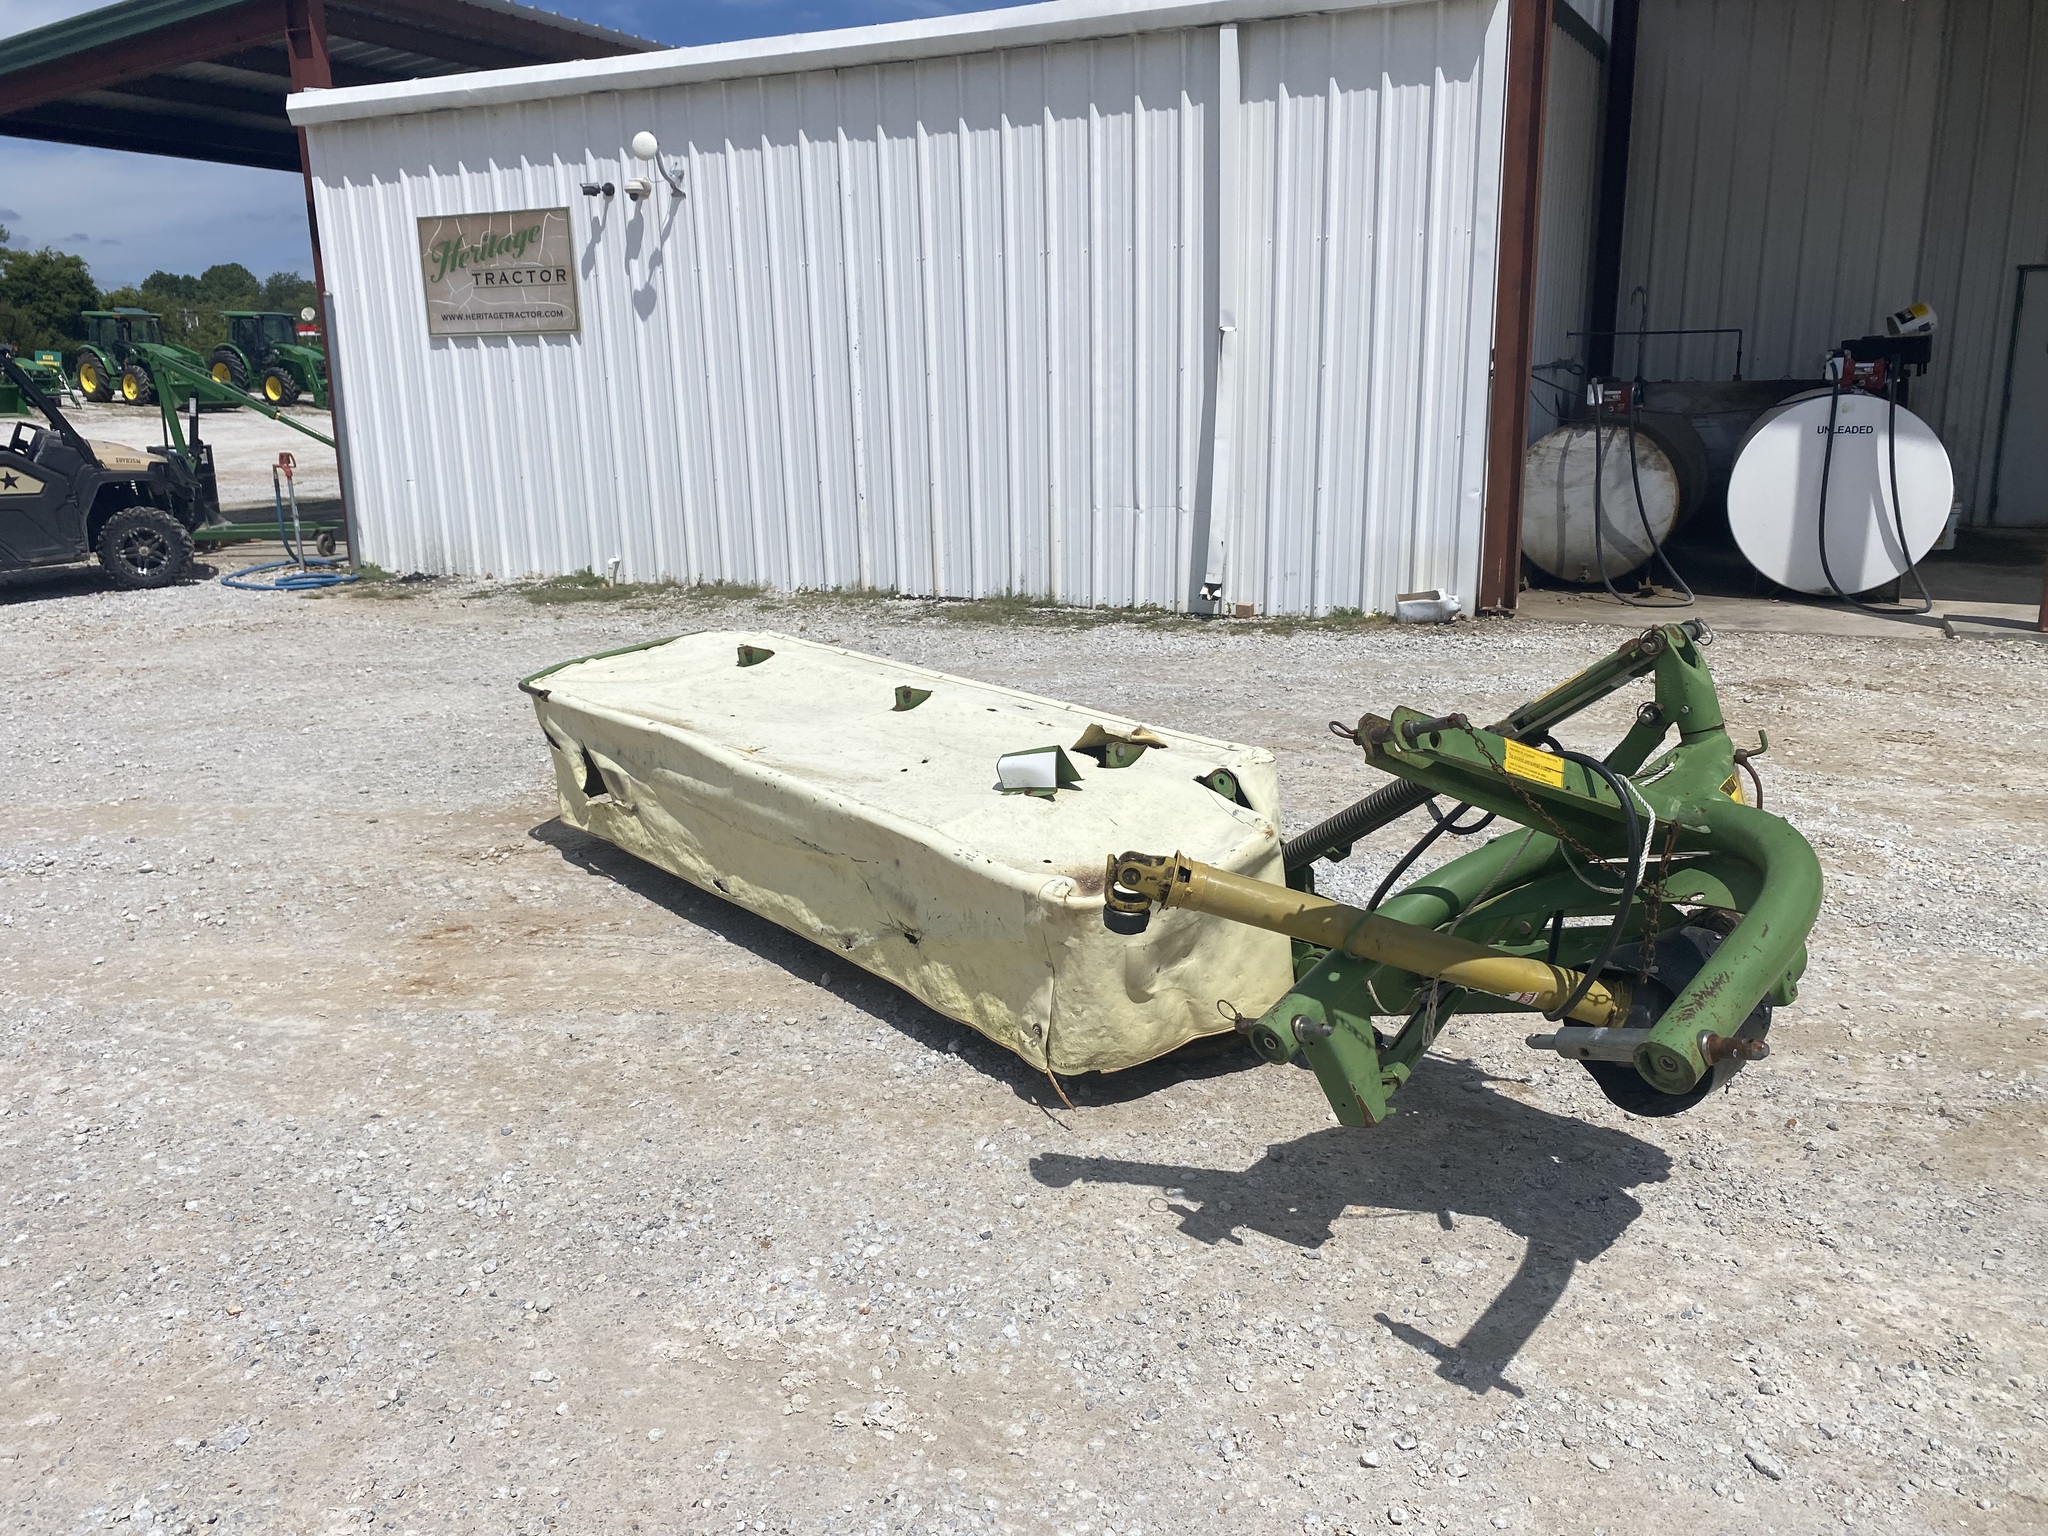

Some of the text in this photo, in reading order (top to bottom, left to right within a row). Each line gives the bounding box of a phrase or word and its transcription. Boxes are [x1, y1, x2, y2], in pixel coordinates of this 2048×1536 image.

[430, 225, 541, 283] Heritage
[472, 268, 567, 286] TRACTOR
[441, 310, 564, 322] WWW.HERITAGETRACTOR.COM
